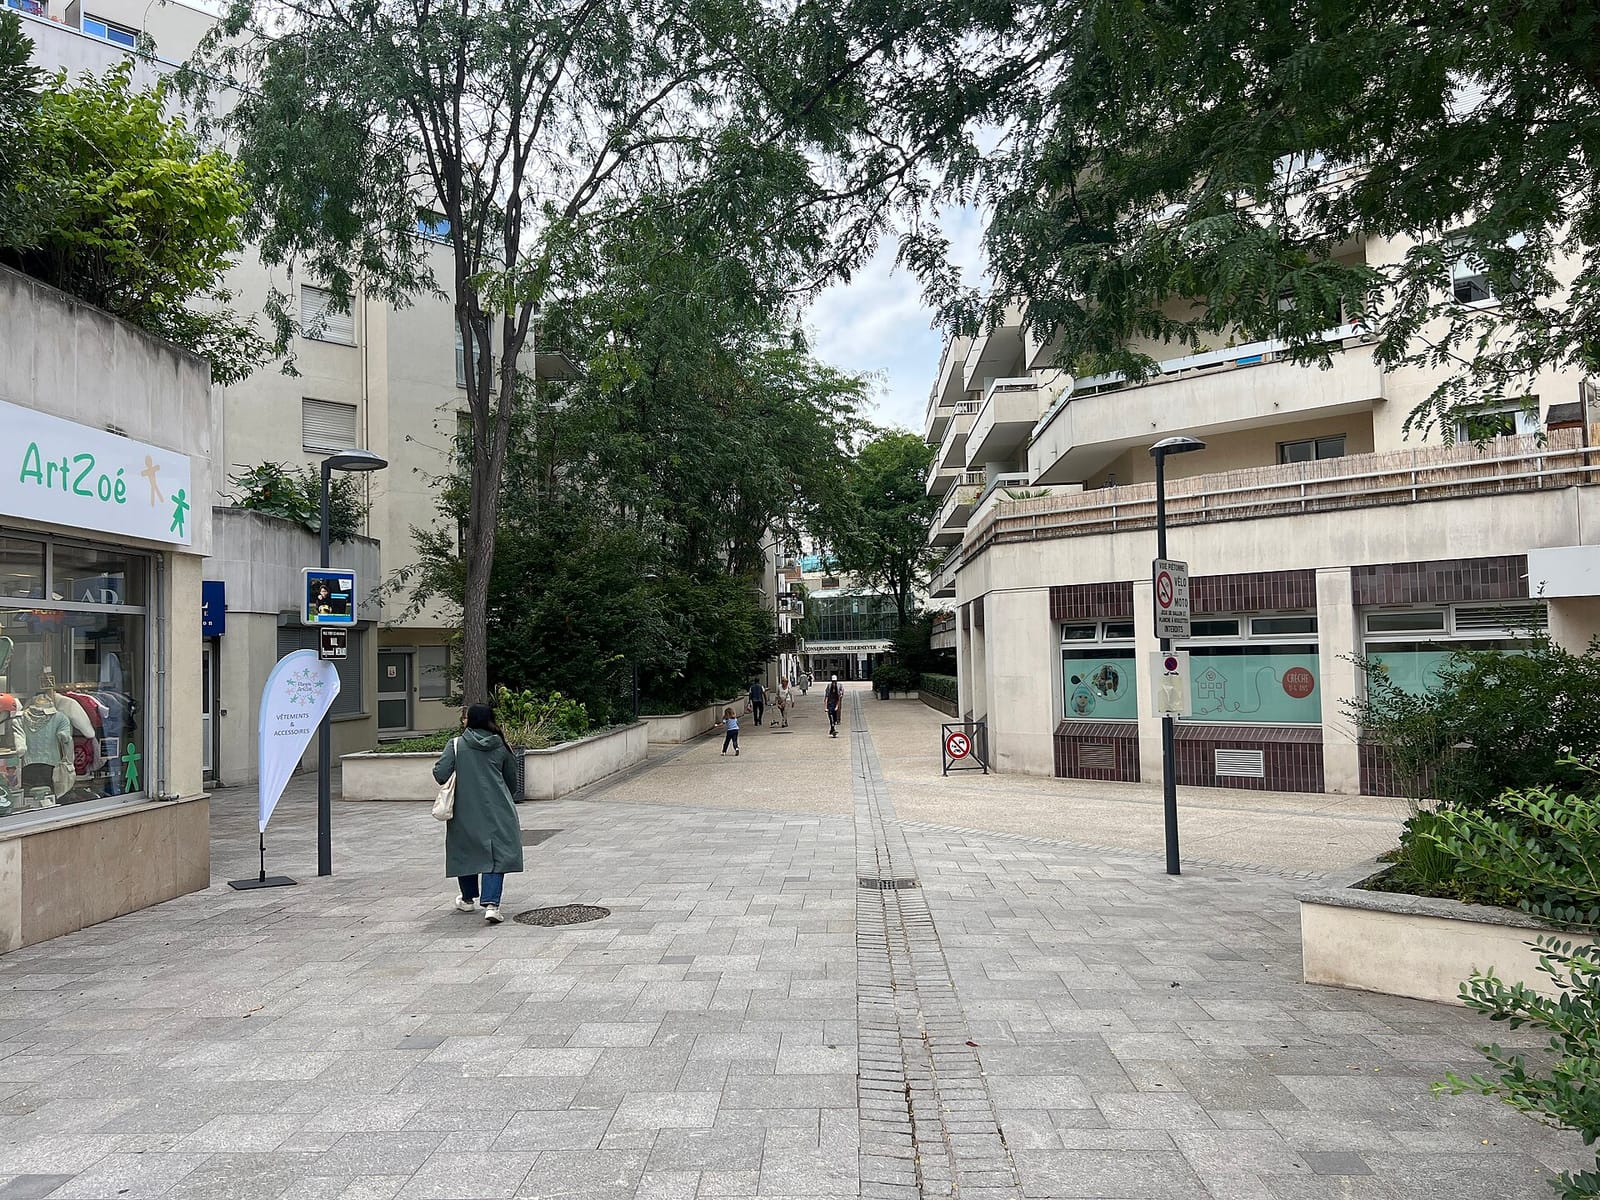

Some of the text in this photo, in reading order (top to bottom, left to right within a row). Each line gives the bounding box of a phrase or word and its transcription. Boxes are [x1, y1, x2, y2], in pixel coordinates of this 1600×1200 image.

[1174, 575, 1187, 588] VÉLO
[1174, 597, 1188, 608] MOTO
[1164, 625, 1184, 633] INTERDITS
[1286, 671, 1310, 684] CRÈCHE
[276, 713, 310, 721] VÊTEMENTS
[273, 728, 310, 737] ACCESSOIRES
